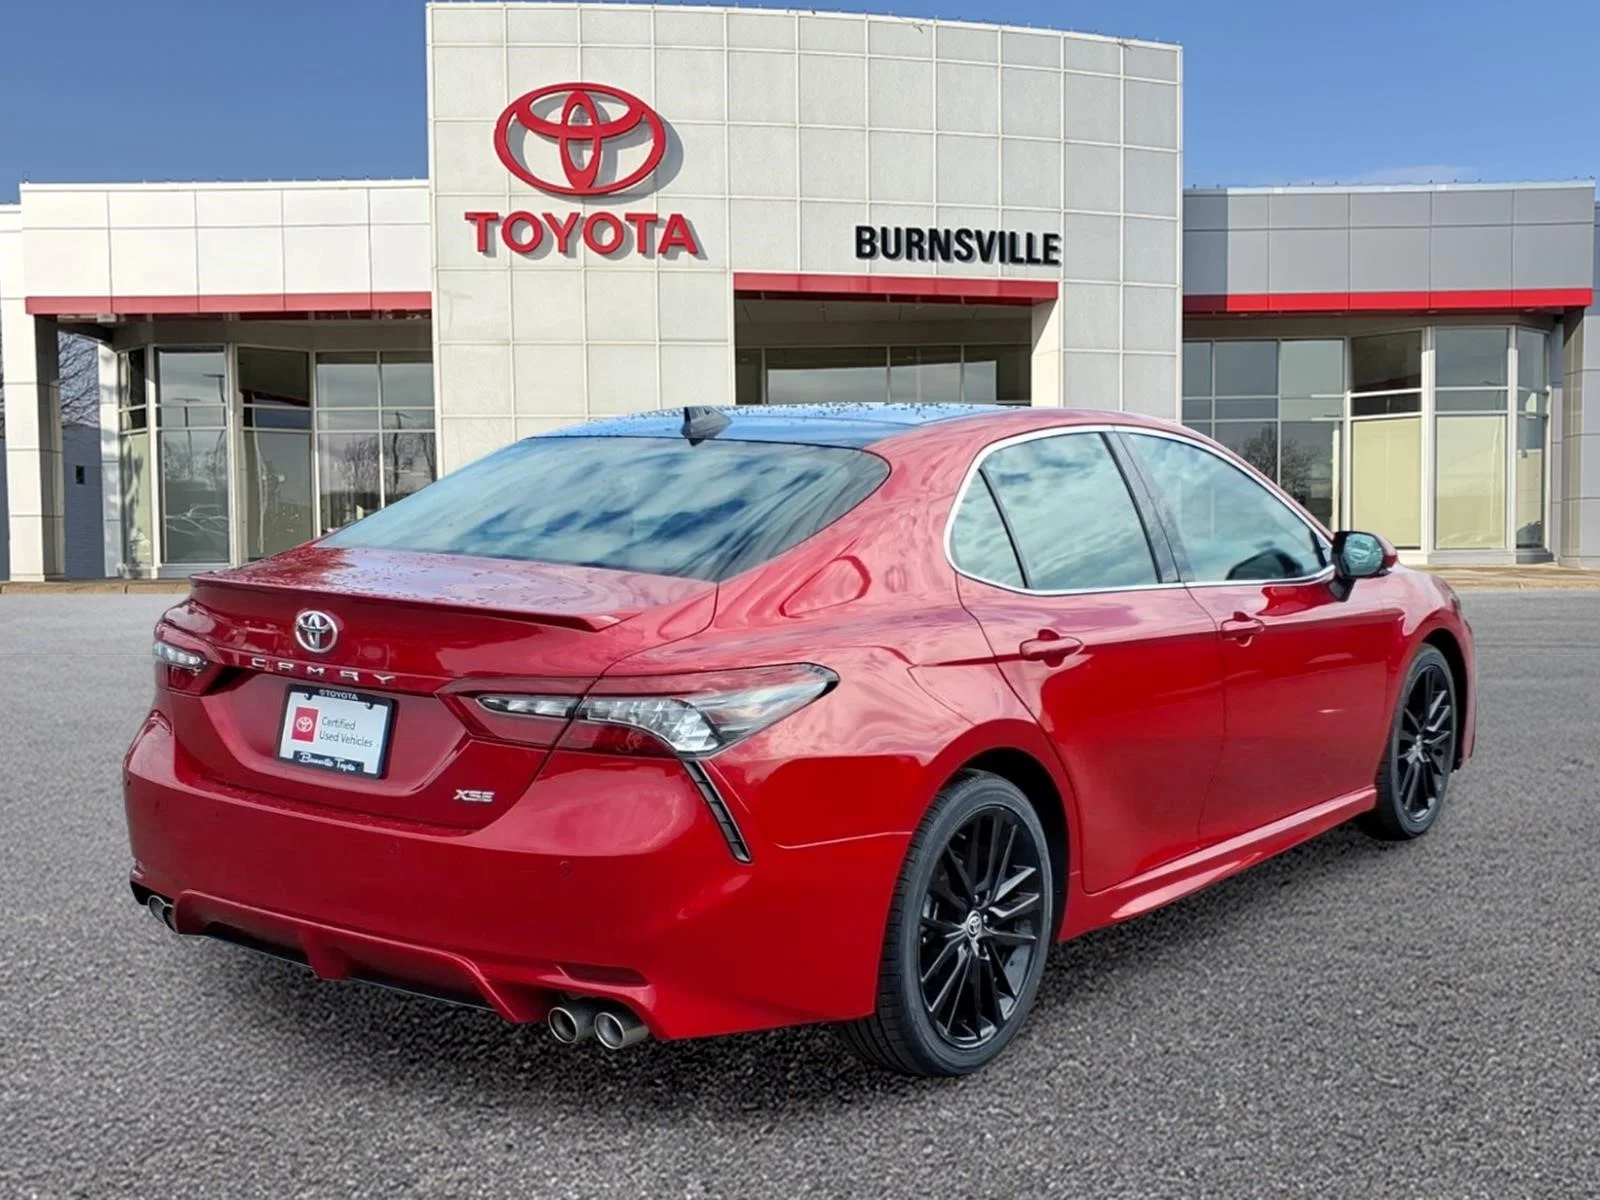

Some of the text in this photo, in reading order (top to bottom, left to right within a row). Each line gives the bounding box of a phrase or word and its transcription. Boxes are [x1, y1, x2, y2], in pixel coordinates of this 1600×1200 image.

[465, 211, 699, 255] TOYOTA
[855, 225, 1061, 266] BURNSVILLE
[251, 656, 396, 685] CAMRY
[326, 690, 358, 701] TOYOTA
[321, 716, 356, 730] Certified
[319, 730, 373, 748] Used Vehicles
[453, 789, 495, 802] XSE
